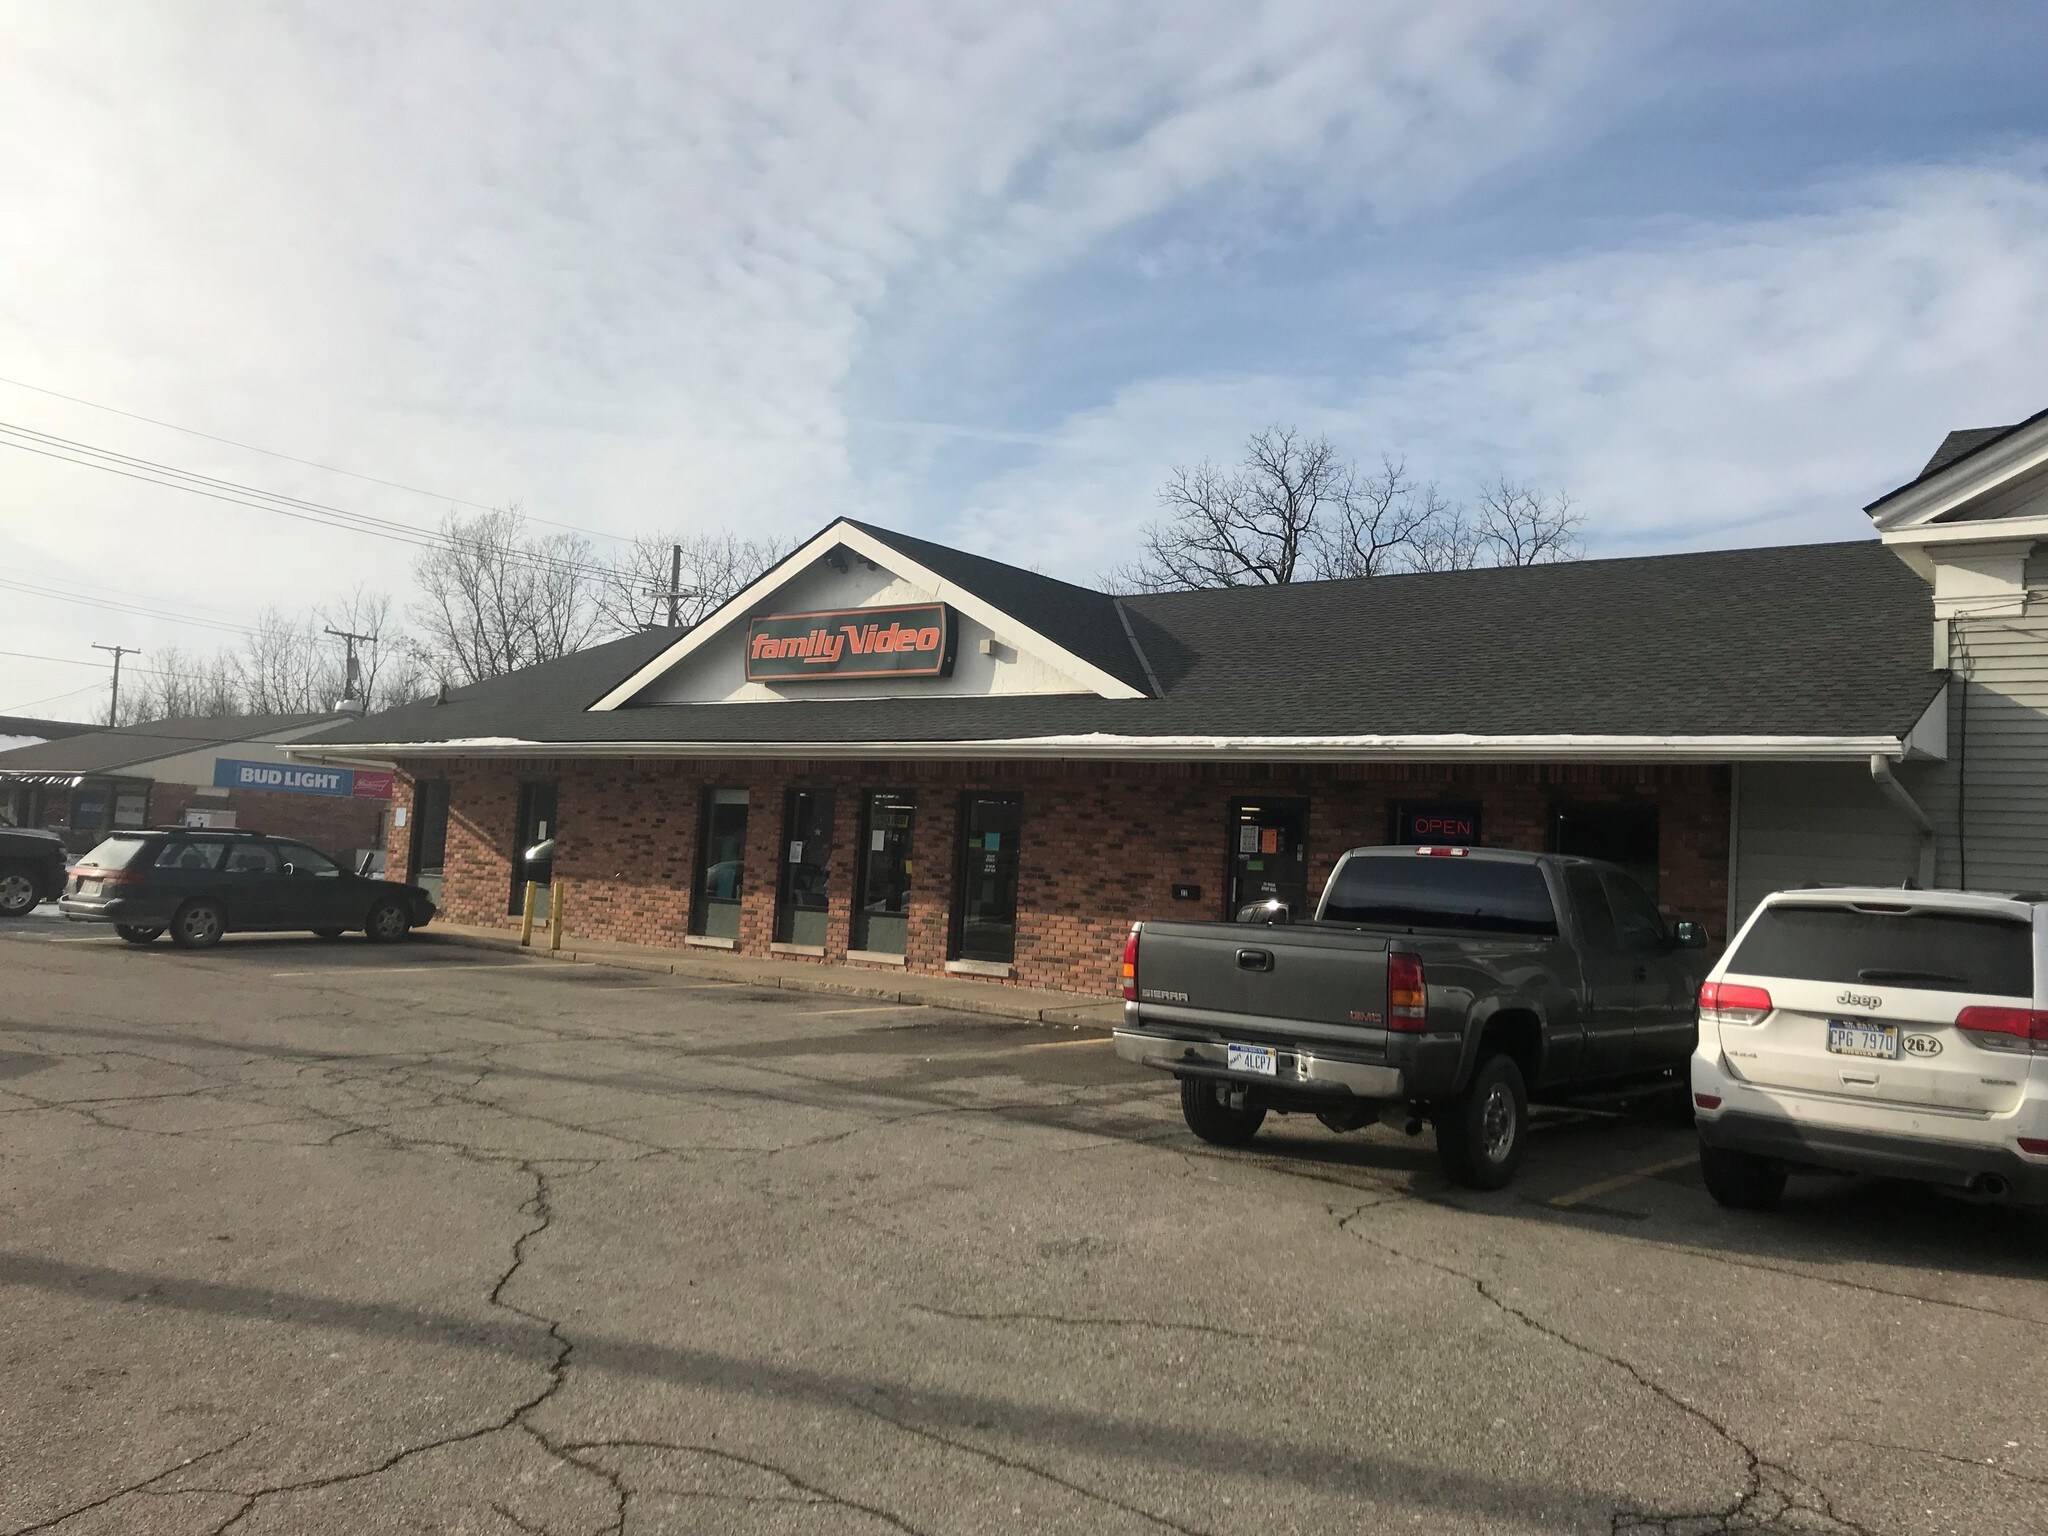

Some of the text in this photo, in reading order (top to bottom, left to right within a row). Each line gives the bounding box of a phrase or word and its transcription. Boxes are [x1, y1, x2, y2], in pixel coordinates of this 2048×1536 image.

[751, 622, 940, 663] family Video
[240, 767, 282, 785] BUD
[283, 771, 340, 789] LIGHT
[1415, 818, 1470, 835] OPEN
[1142, 989, 1188, 1002] SIERRA
[1837, 990, 1882, 1010] Jeep
[1862, 1032, 1893, 1051] 7970
[1907, 1038, 1937, 1053] 26.2
